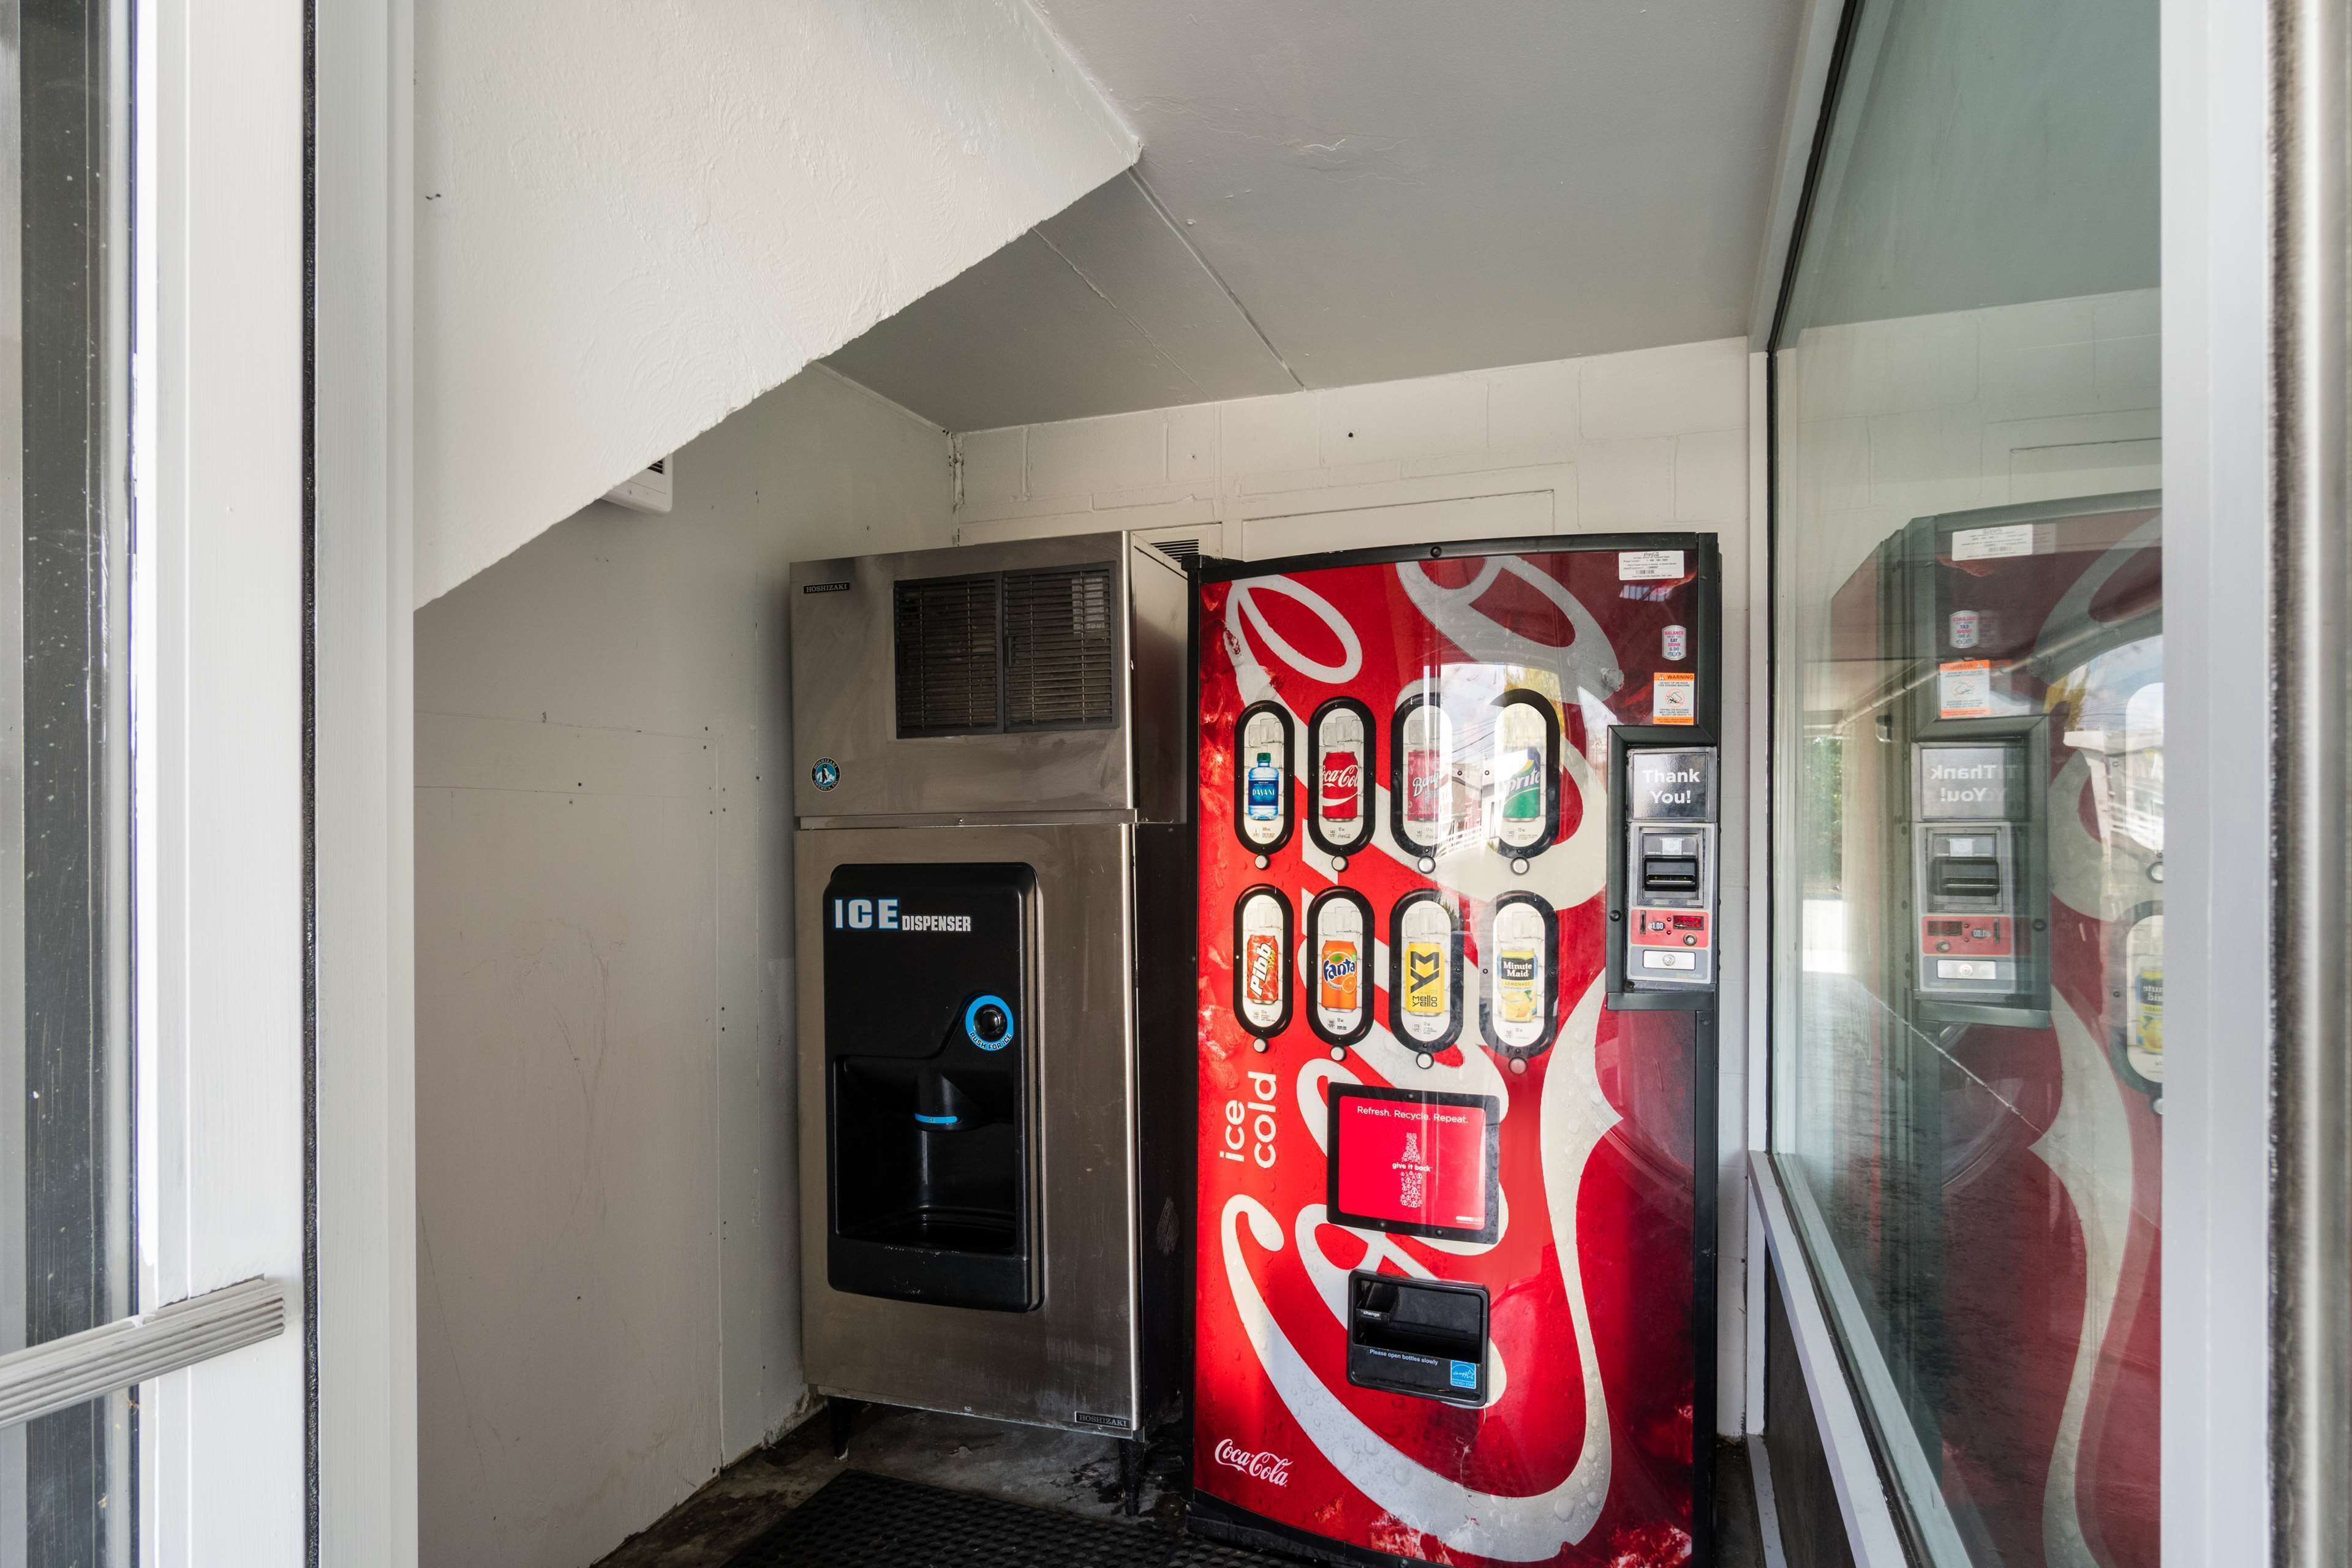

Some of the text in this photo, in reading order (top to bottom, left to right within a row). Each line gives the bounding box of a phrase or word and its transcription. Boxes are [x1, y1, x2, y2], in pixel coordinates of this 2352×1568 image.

[806, 584, 846, 593] HOSHIZAKI
[1502, 766, 1540, 798] prite
[1642, 768, 1700, 783] Thank
[1649, 790, 1691, 804] You!
[835, 899, 971, 932] ICE DISPENSER
[1250, 943, 1272, 998] Pibb
[1503, 960, 1532, 970] Minute
[970, 1032, 986, 1048] PUSH
[1002, 1033, 1012, 1045] ICE
[1248, 1071, 1277, 1169] cold
[1357, 1106, 1469, 1124] Refresh. Recycle. Repeat.
[1219, 1099, 1245, 1162] ice
[1421, 1357, 1438, 1366] slowly
[1079, 1414, 1127, 1427] HOSHIZAKI
[1215, 1439, 1294, 1487] Coca-Cola
